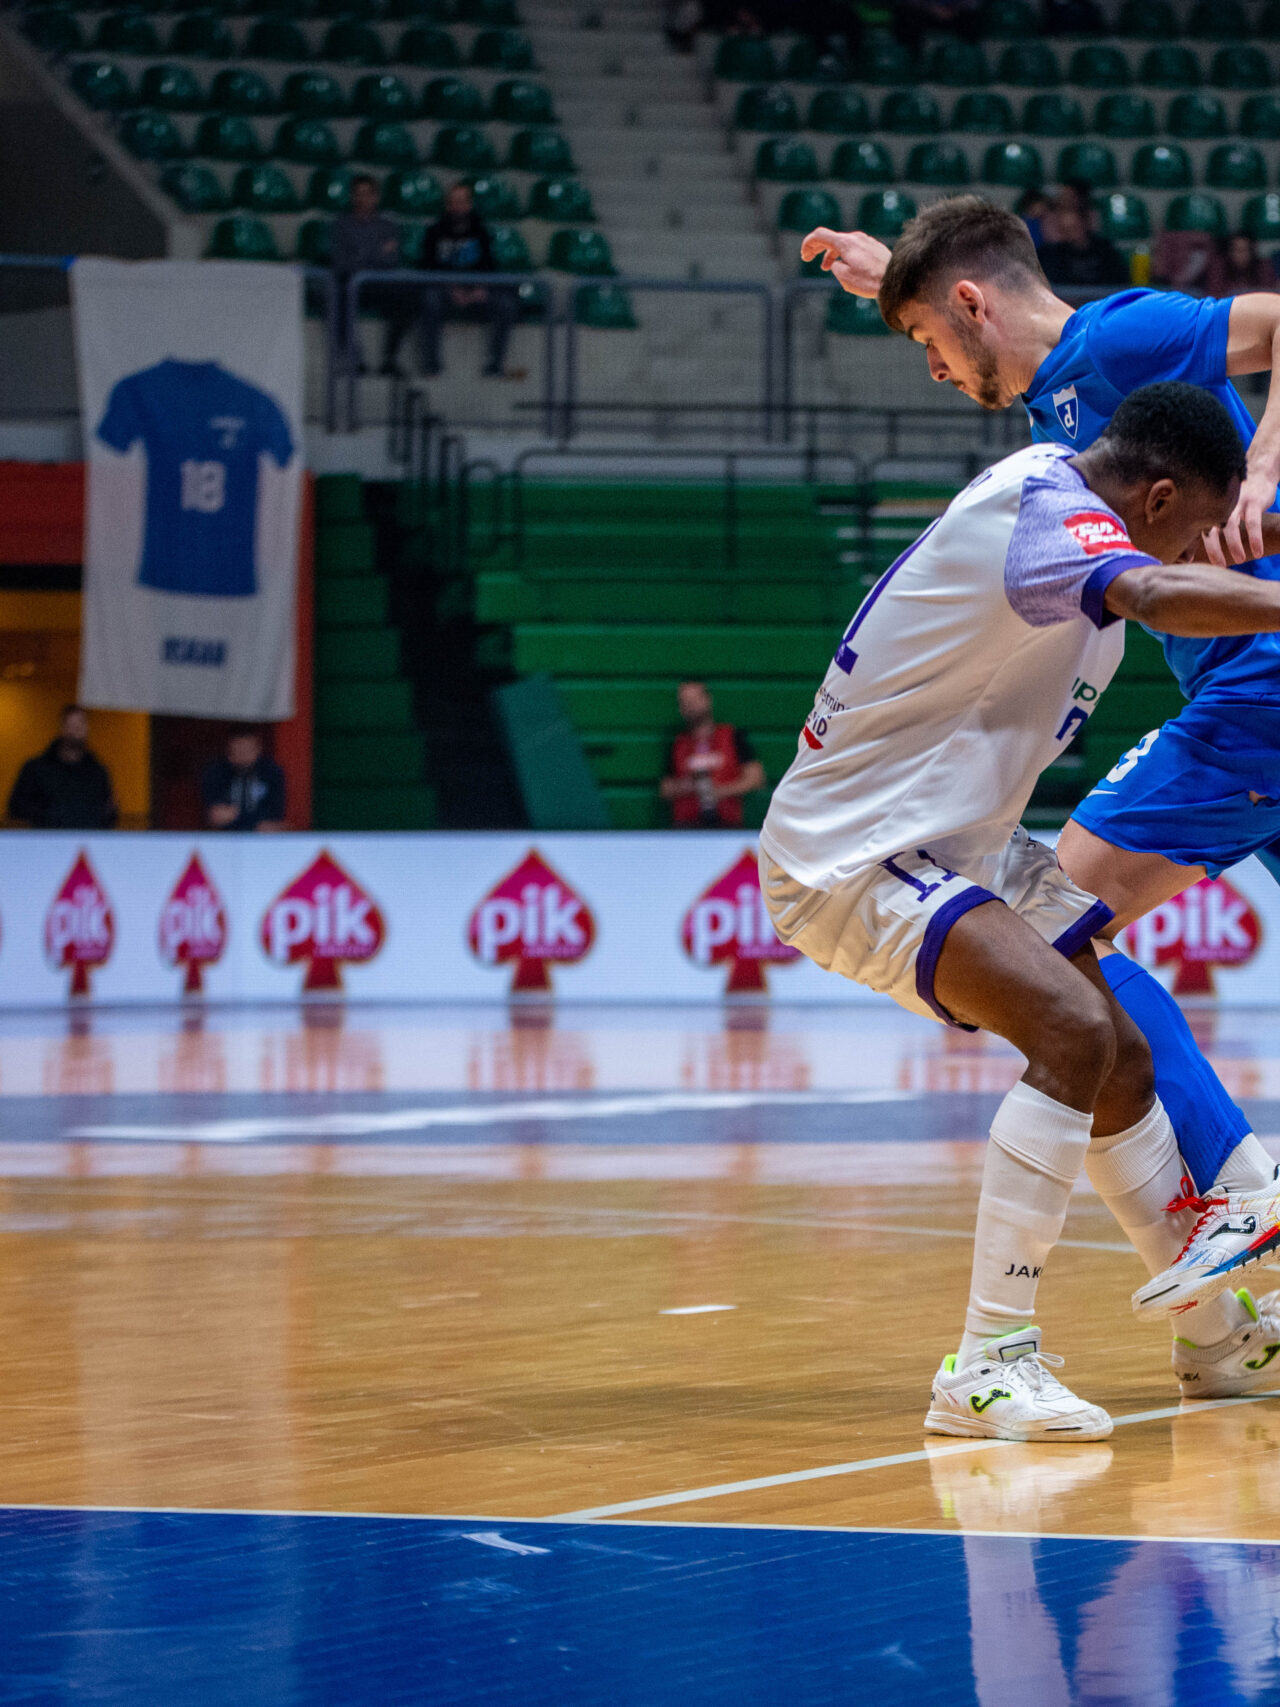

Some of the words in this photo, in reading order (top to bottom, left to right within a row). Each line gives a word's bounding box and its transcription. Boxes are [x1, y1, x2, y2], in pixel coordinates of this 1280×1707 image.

[180, 460, 226, 513] 18
[51, 885, 108, 962] pik
[164, 885, 220, 962] pik
[271, 883, 375, 964] pik
[478, 883, 583, 965] pik
[1134, 885, 1250, 969] pik
[1004, 1263, 1044, 1279] JAK
